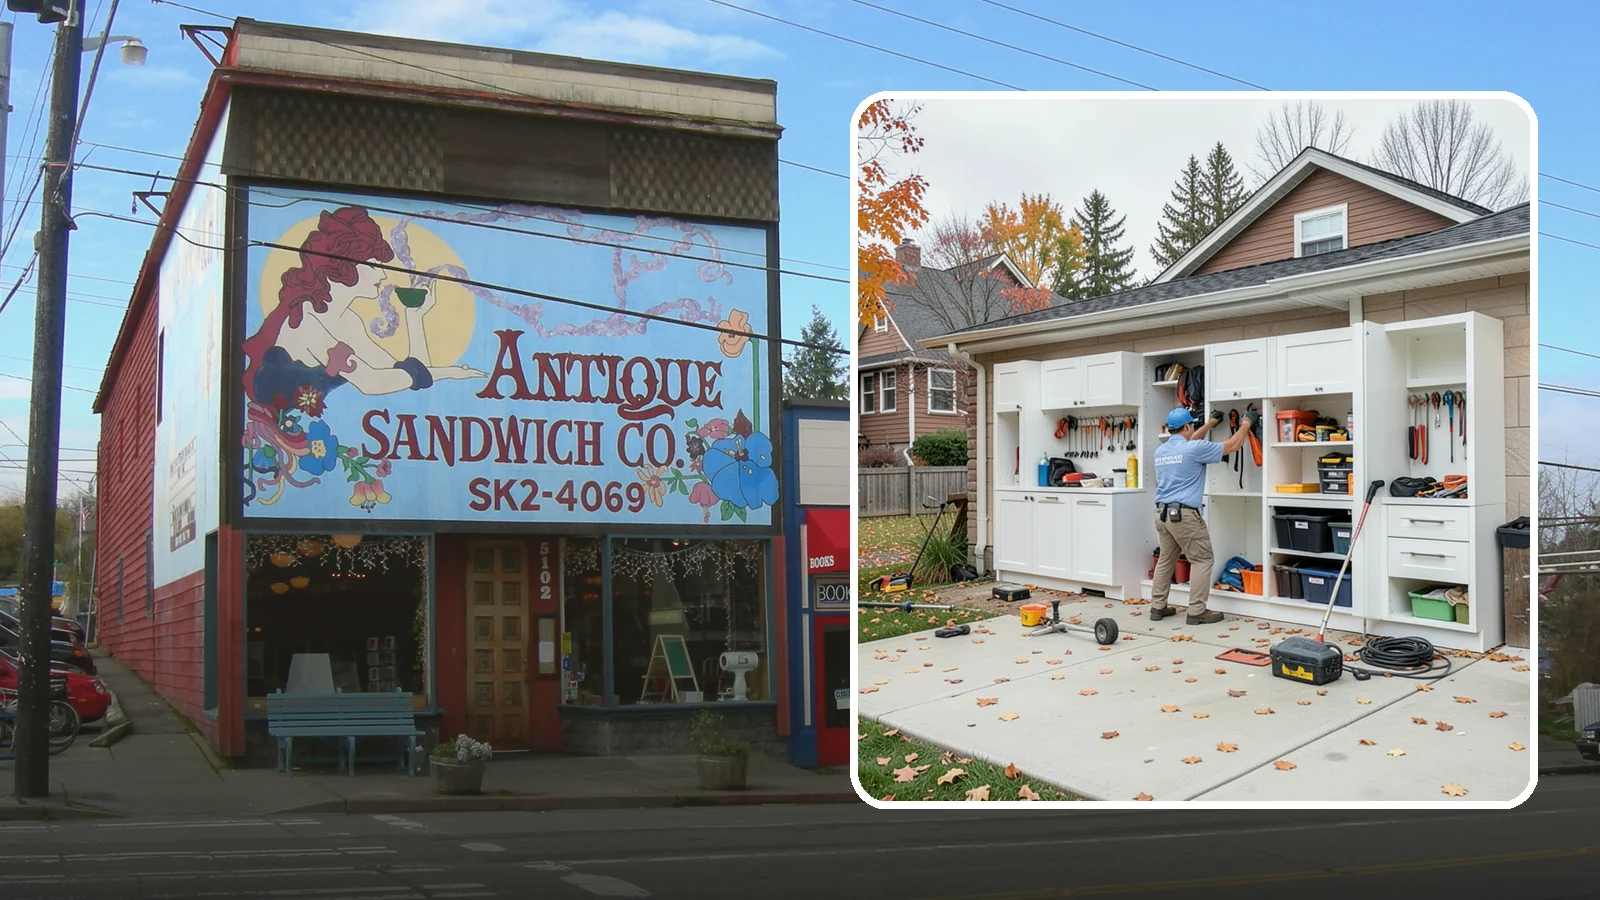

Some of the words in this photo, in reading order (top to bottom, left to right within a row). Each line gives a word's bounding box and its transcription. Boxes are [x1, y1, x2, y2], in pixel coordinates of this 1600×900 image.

[475, 329, 723, 421] ANTIQUE
[361, 408, 605, 468] SANDWICH
[617, 422, 686, 469] CO.
[468, 477, 646, 513] SK2-4069
[540, 541, 551, 600] 5102
[809, 555, 835, 569] BOOKS
